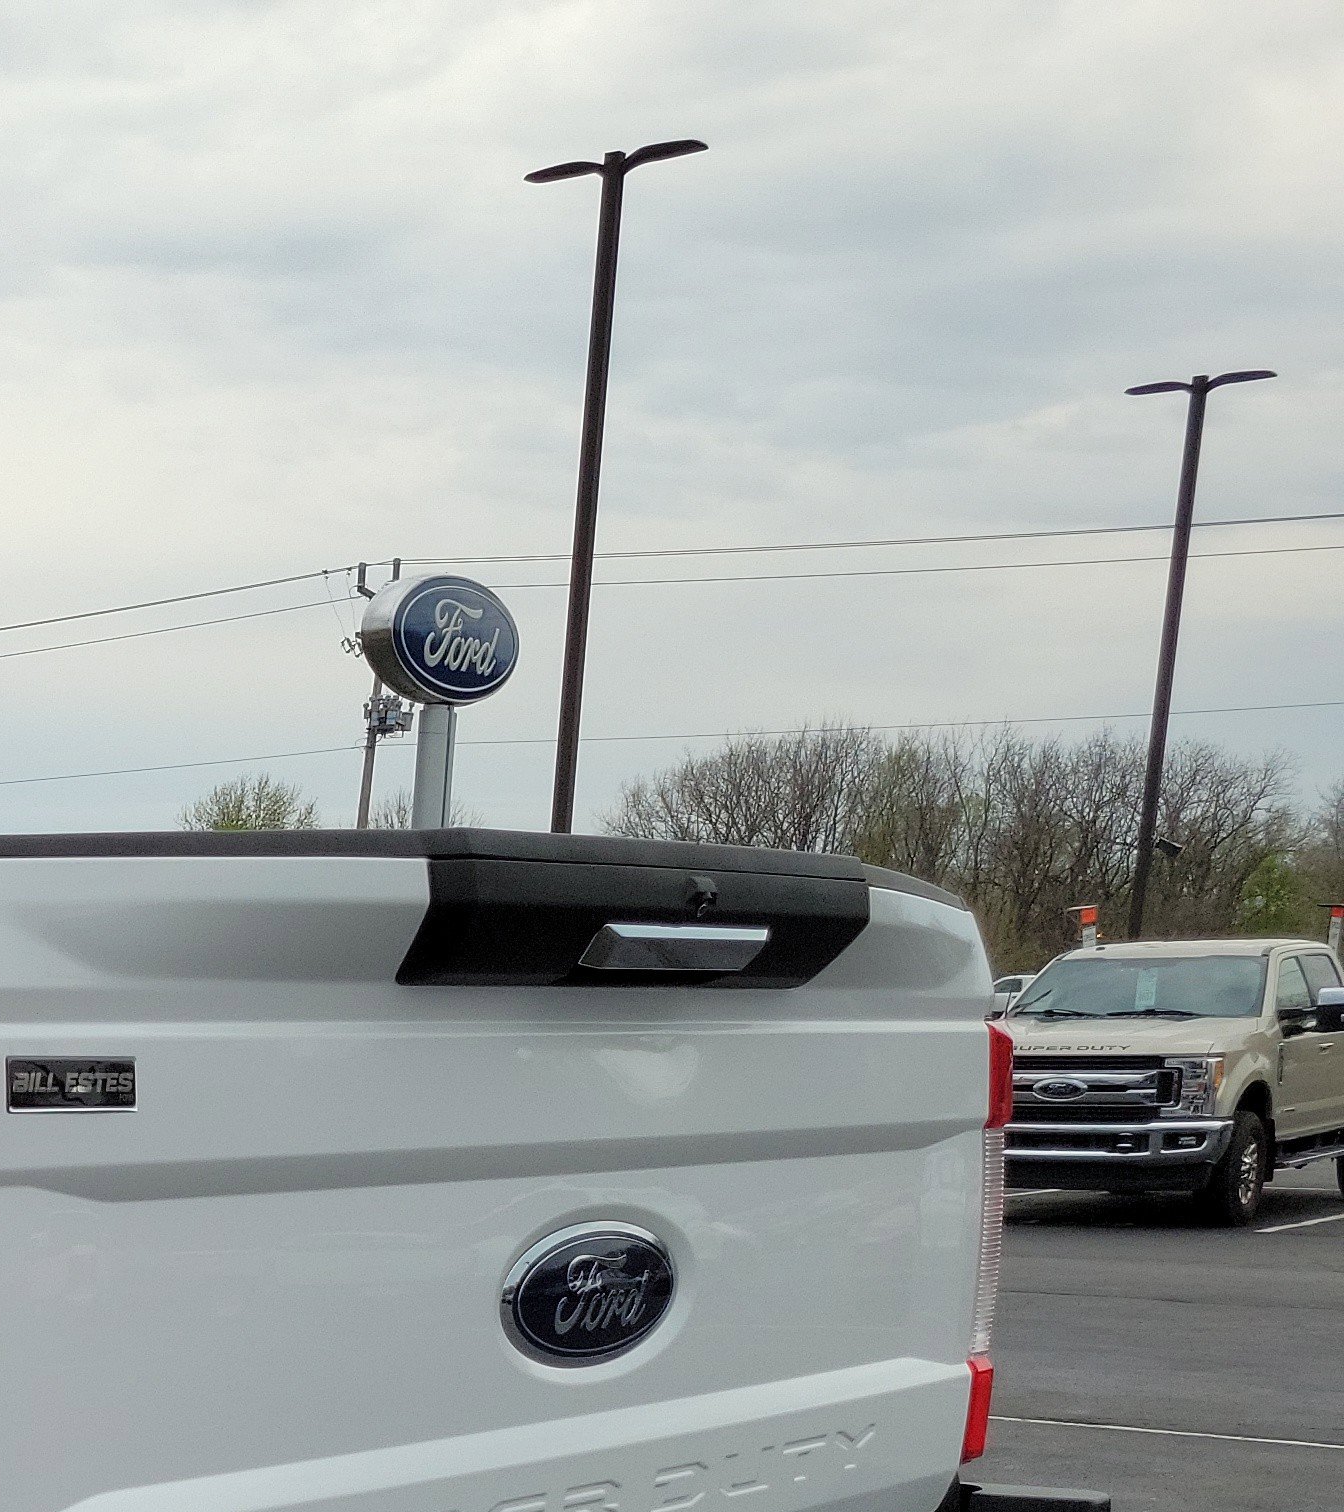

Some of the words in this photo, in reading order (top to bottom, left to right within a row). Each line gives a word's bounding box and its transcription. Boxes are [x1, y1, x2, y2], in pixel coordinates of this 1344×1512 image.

[423, 599, 500, 677] Ford
[13, 1072, 60, 1093] BILL
[65, 1072, 134, 1093] ESTES
[554, 1254, 650, 1334] Ford
